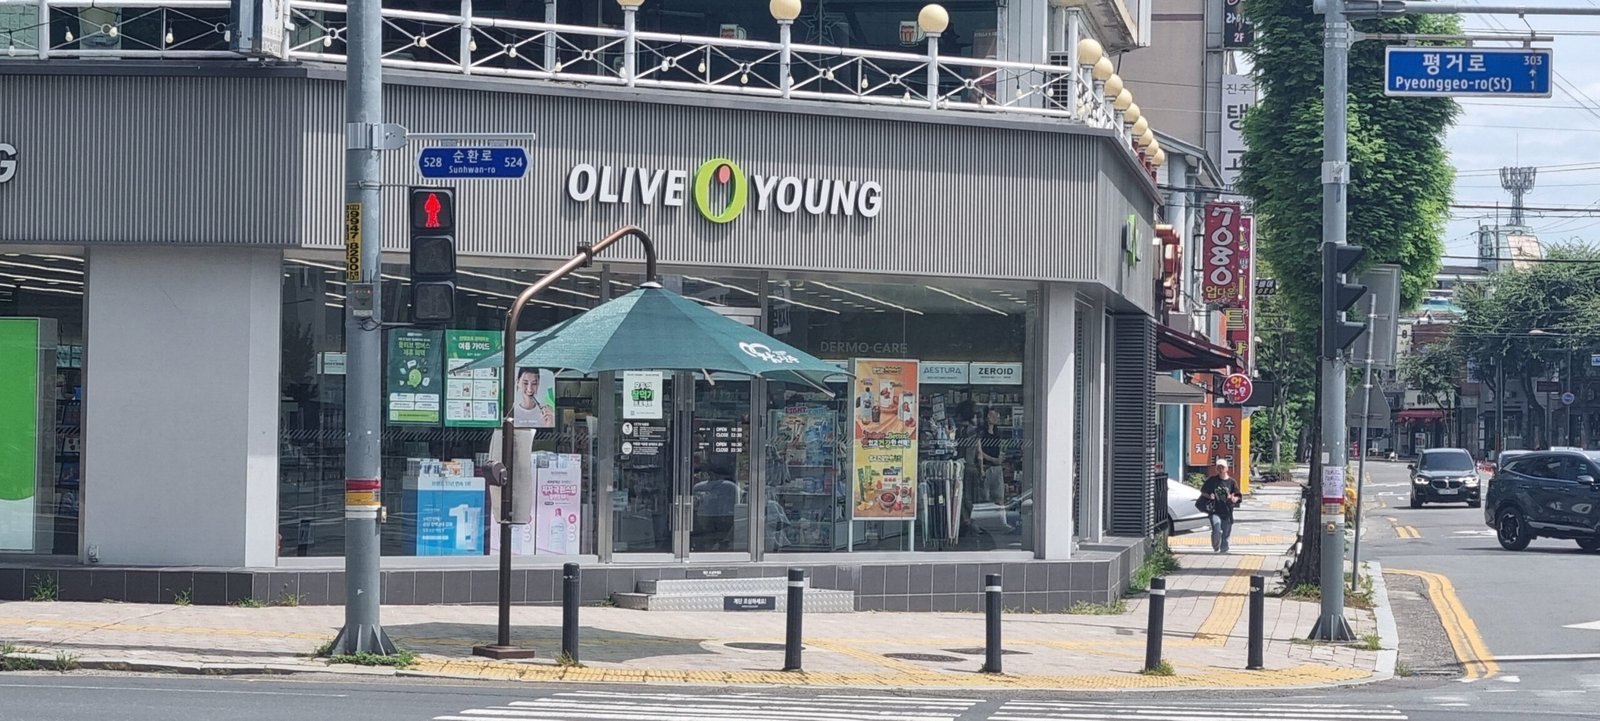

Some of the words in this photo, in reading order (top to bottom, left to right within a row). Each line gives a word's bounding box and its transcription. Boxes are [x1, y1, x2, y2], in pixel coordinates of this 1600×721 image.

[1233, 32, 1245, 43] 2F
[1422, 53, 1488, 75] 평거로
[1523, 56, 1543, 66] 303
[1226, 83, 1252, 95] 진주
[1396, 76, 1512, 92] Pyeonggeo-ro(St)
[1530, 80, 1535, 90] 1
[453, 149, 493, 163] 순환로
[424, 157, 443, 167] 528
[504, 157, 523, 167] 524
[449, 166, 496, 174] Sunhwan-ro
[568, 163, 687, 206] OLIVE
[753, 174, 883, 218] YOUNG
[1210, 206, 1234, 286] 7080
[458, 341, 471, 350] 여름
[472, 341, 491, 350] 가이드
[923, 366, 962, 375] AESTURA
[978, 367, 1014, 376] ZEROID
[1195, 411, 1208, 455] 건강차
